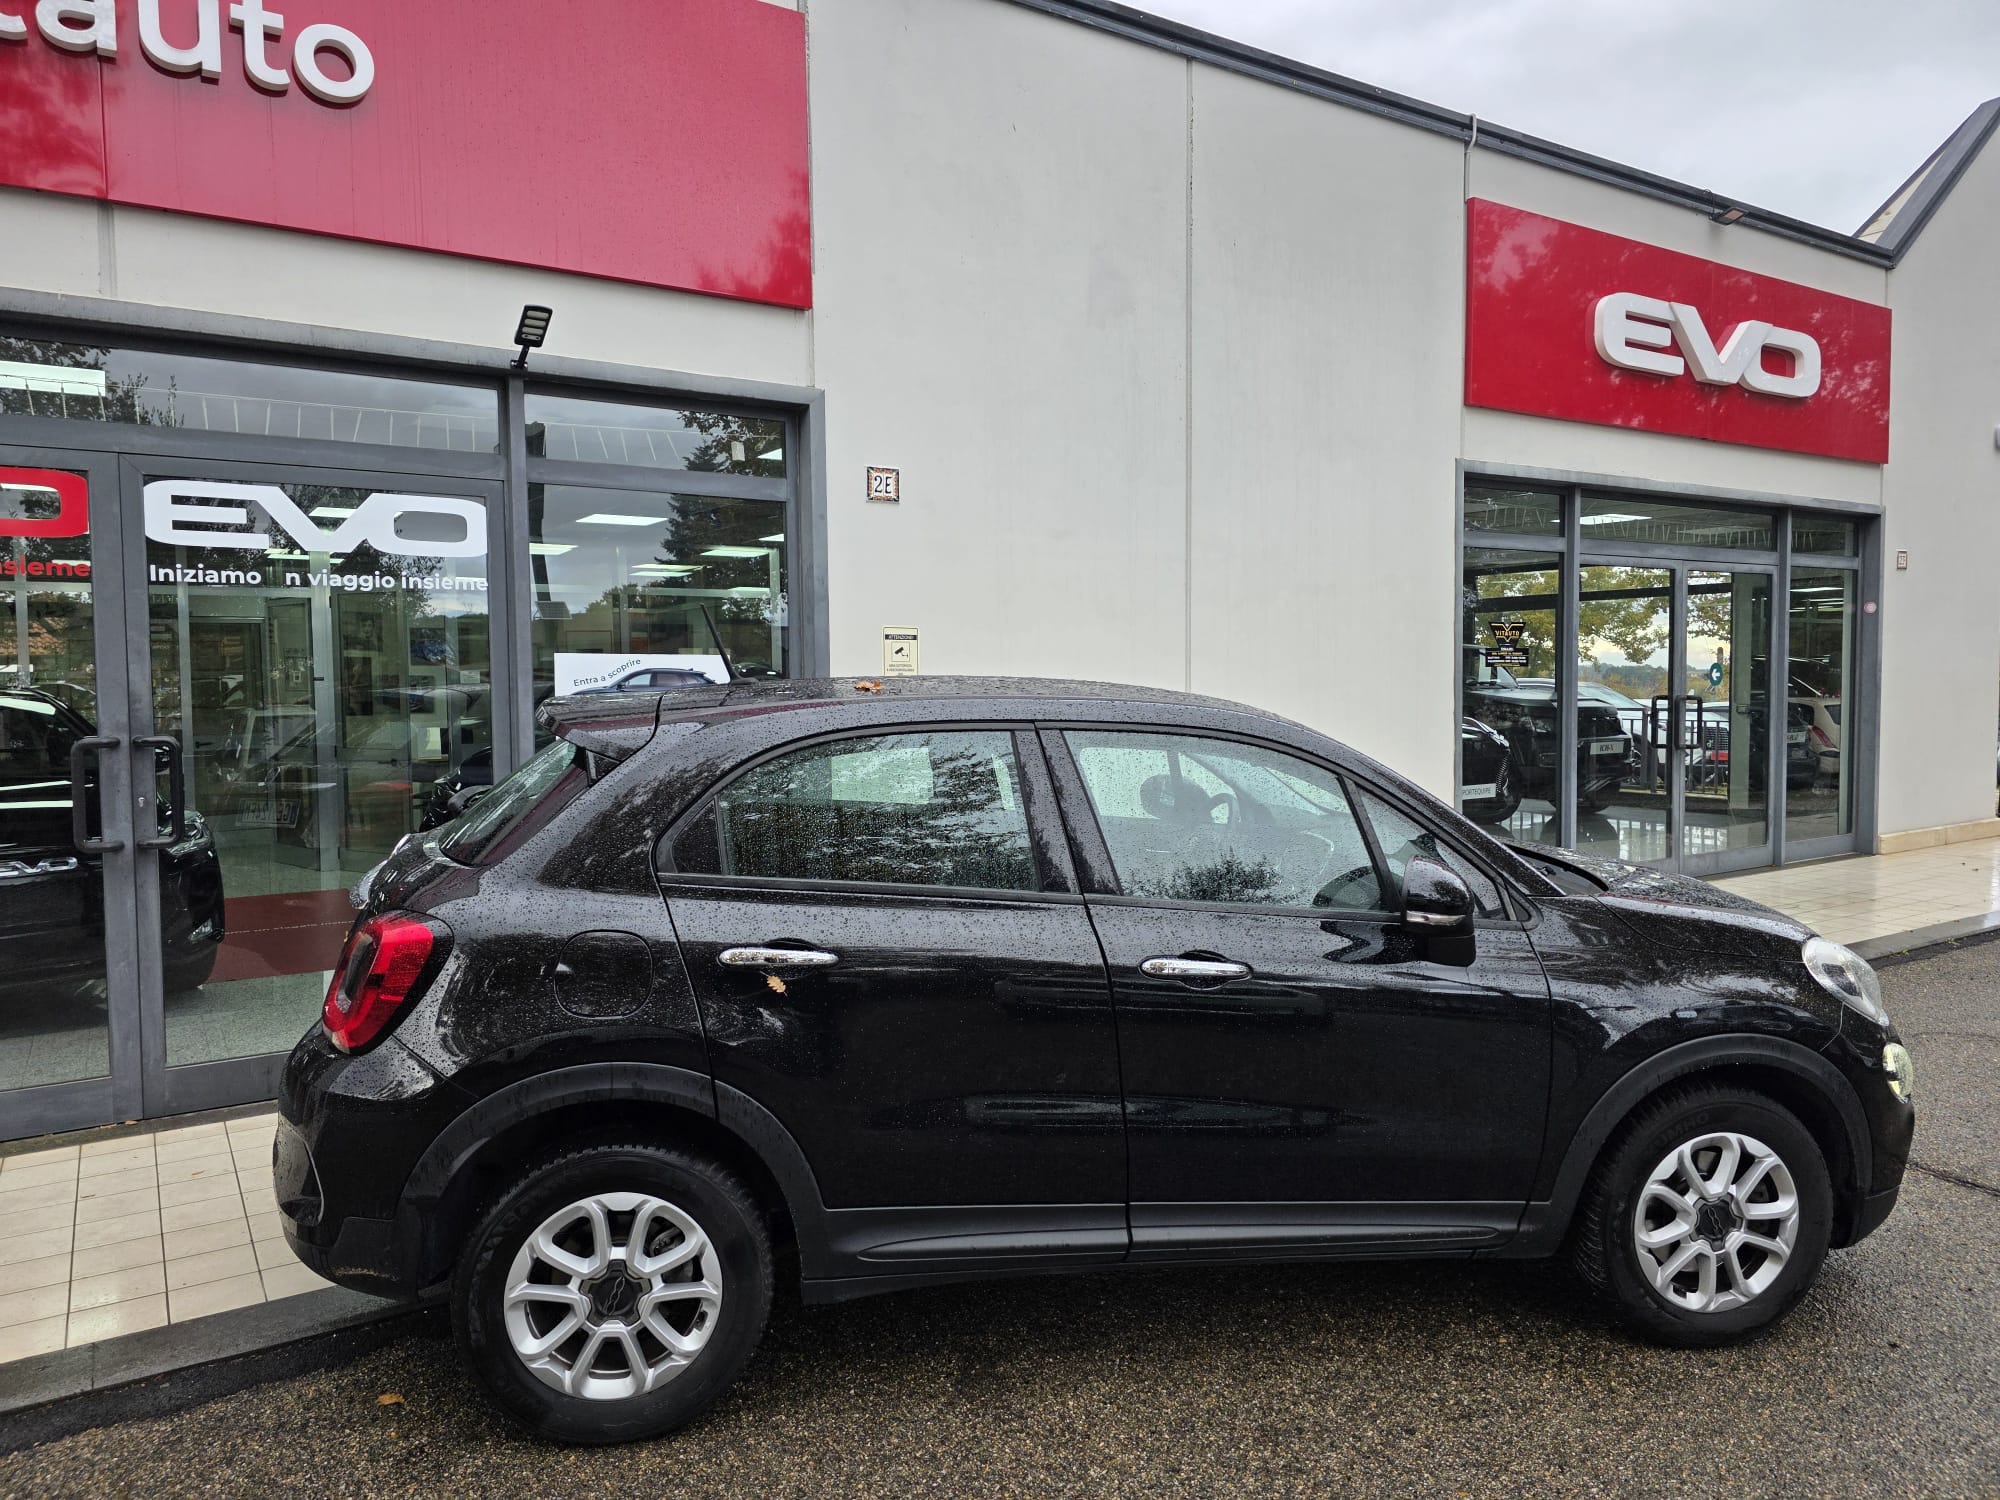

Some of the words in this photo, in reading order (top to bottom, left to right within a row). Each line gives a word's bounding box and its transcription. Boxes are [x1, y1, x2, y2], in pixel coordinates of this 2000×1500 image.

[0, 0, 375, 104] auto
[1594, 292, 1822, 398] EVO
[874, 475, 892, 494] 2E
[143, 479, 488, 557] EVO
[0, 553, 91, 577] sieme
[150, 563, 262, 585] Iniziamo
[307, 568, 396, 592] viaggio
[401, 570, 488, 591] insieme
[573, 677, 599, 687] Entra
[607, 659, 641, 679] scoprire
